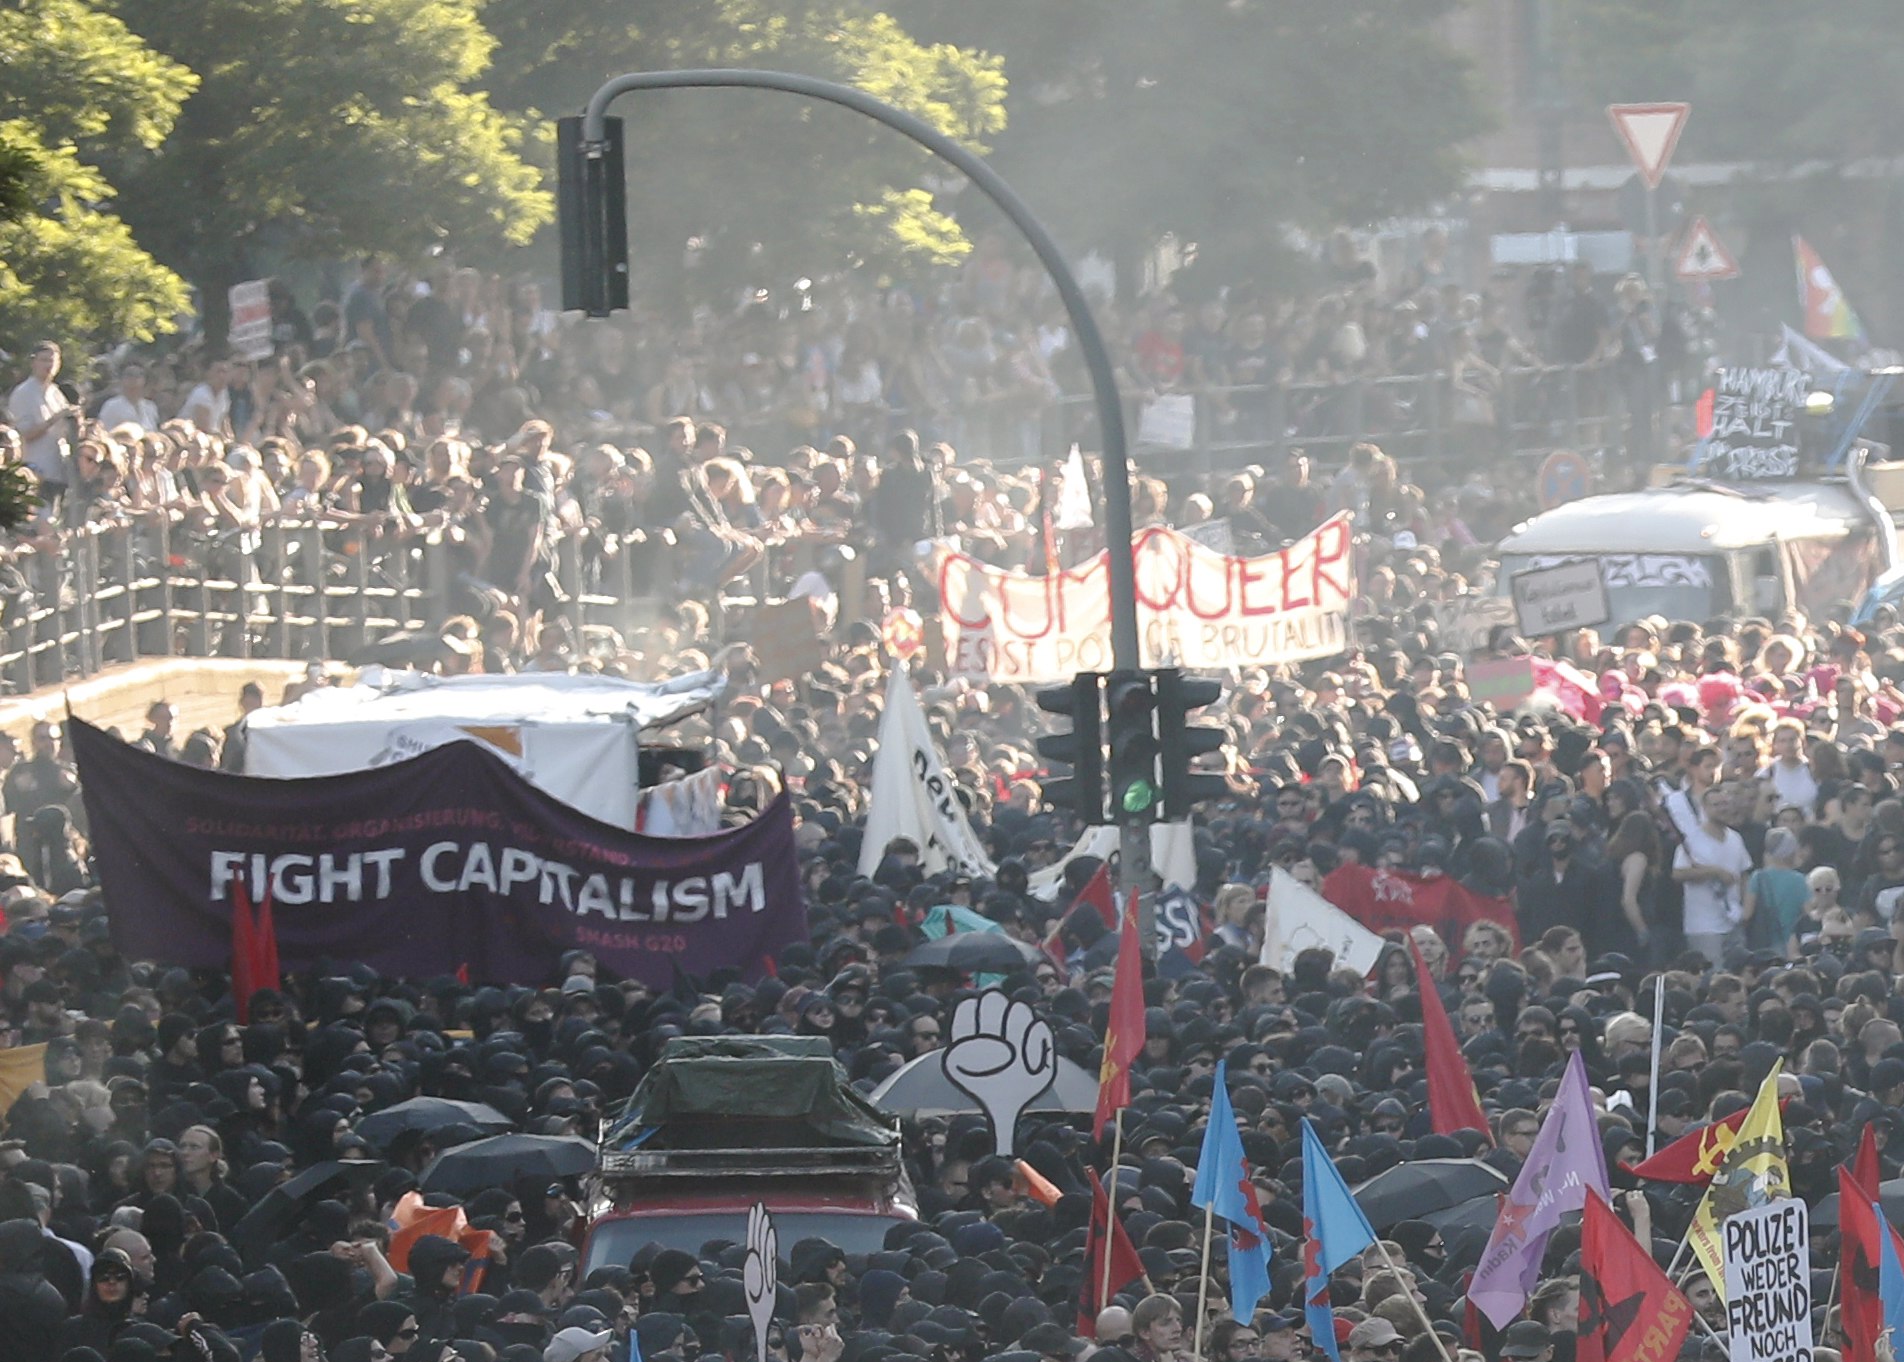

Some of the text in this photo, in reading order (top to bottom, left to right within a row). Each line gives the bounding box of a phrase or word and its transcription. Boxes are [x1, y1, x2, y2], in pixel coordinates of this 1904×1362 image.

[1132, 521, 1350, 620] QUEER
[210, 841, 766, 922] FIGHT CAPITALISM
[1726, 1206, 1804, 1264] POLIZEI
[1741, 1253, 1801, 1292] WEDER
[1728, 1282, 1808, 1338] FREUND
[1750, 1329, 1797, 1360] NOCH
